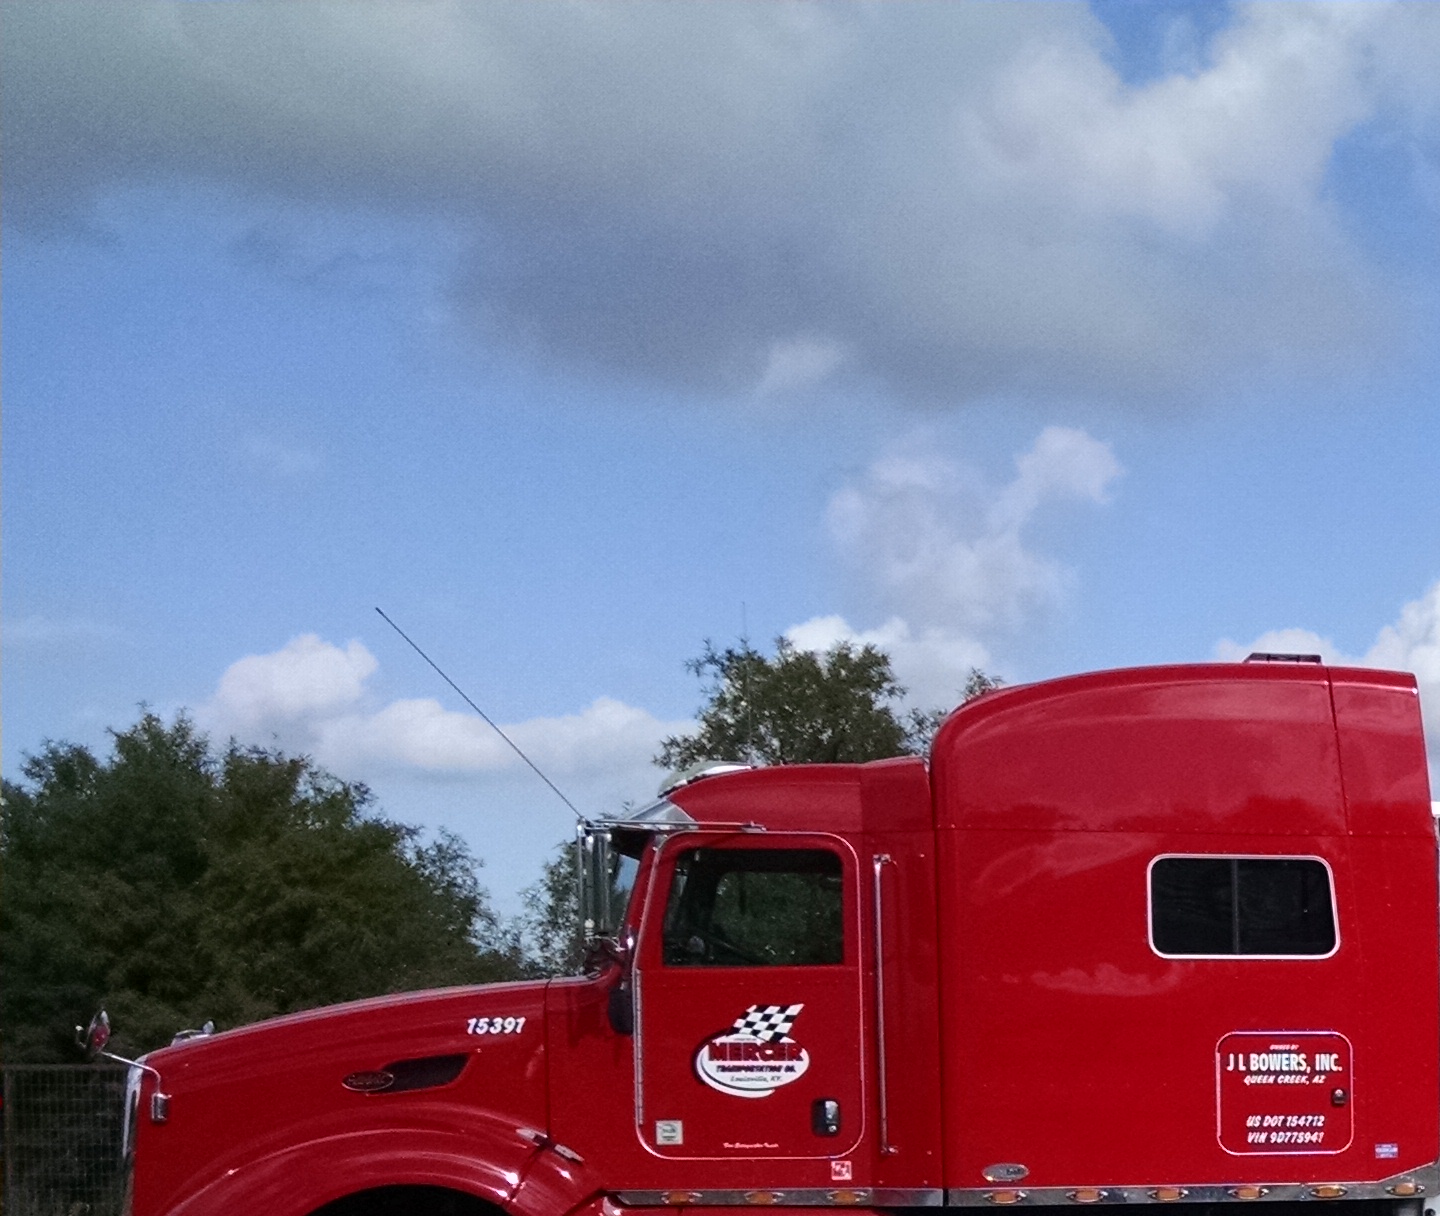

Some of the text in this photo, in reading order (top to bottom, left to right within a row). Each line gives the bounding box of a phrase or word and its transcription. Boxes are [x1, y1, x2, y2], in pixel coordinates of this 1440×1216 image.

[466, 1016, 526, 1035] 15391
[708, 1042, 804, 1062] MERCER
[1226, 1053, 1343, 1073] J L BOWERS, INC.
[1243, 1075, 1327, 1085] QUEEN CREEK, AZ
[1246, 1115, 1325, 1127] US DOT 154712
[1247, 1131, 1268, 1143] VIN
